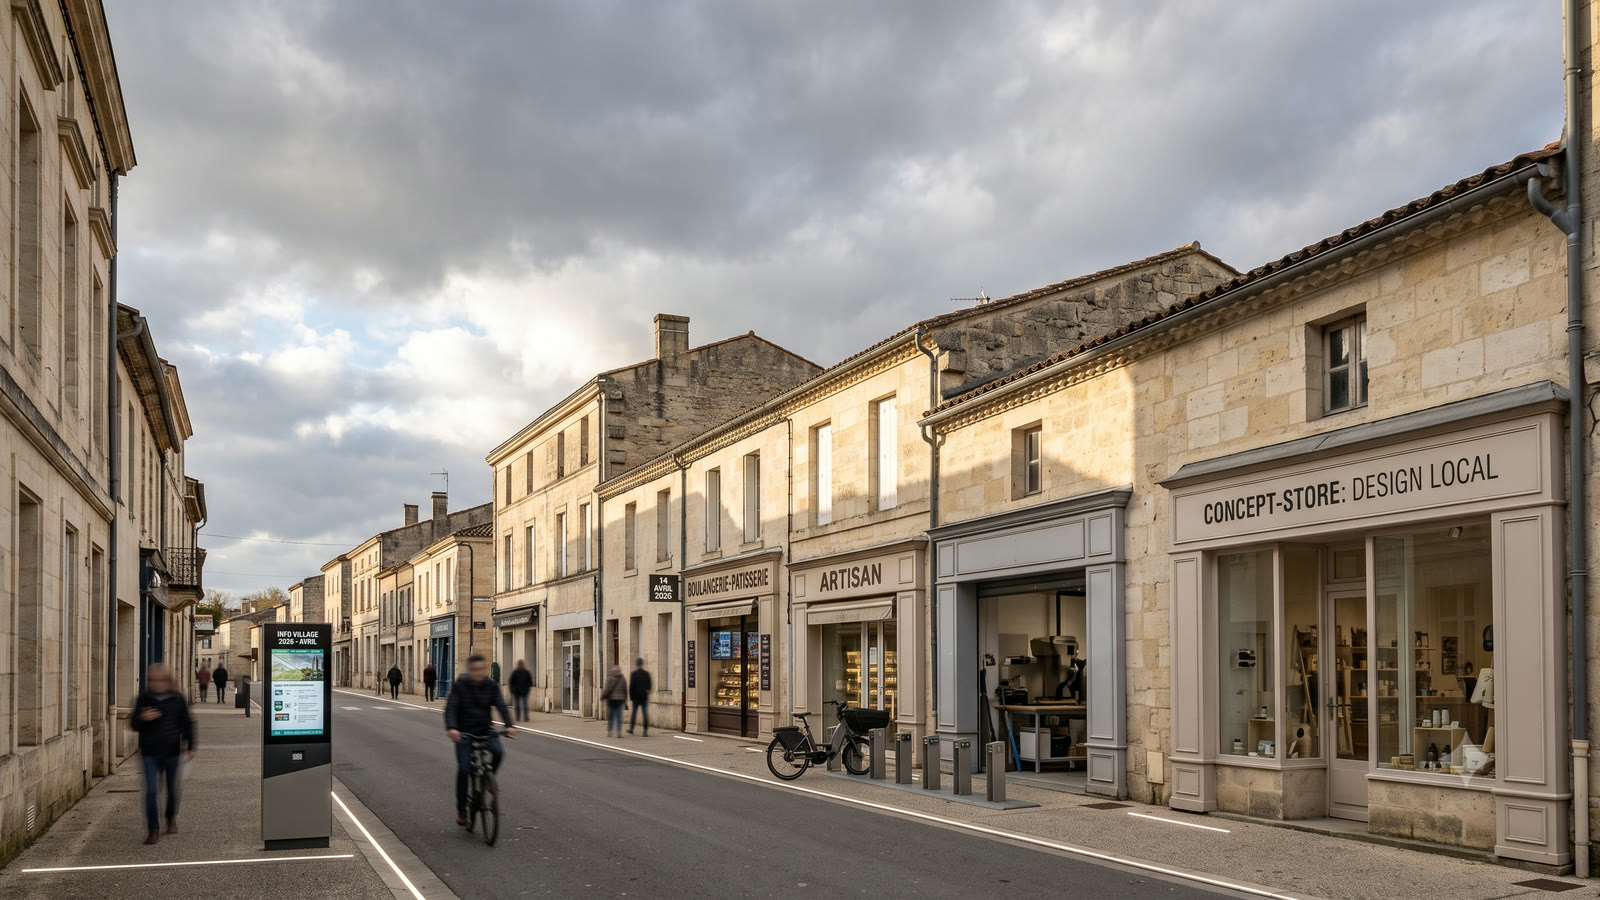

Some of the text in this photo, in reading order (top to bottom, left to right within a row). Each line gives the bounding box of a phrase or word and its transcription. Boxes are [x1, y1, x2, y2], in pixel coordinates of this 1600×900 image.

[1203, 453, 1499, 525] CONCEPT-STORE: DESIGN LOCAL
[687, 567, 769, 598] BOULANGERIE-PATISSERIE
[819, 562, 882, 593] ARTISAN
[654, 592, 673, 600] 2026
[277, 630, 292, 638] INFO
